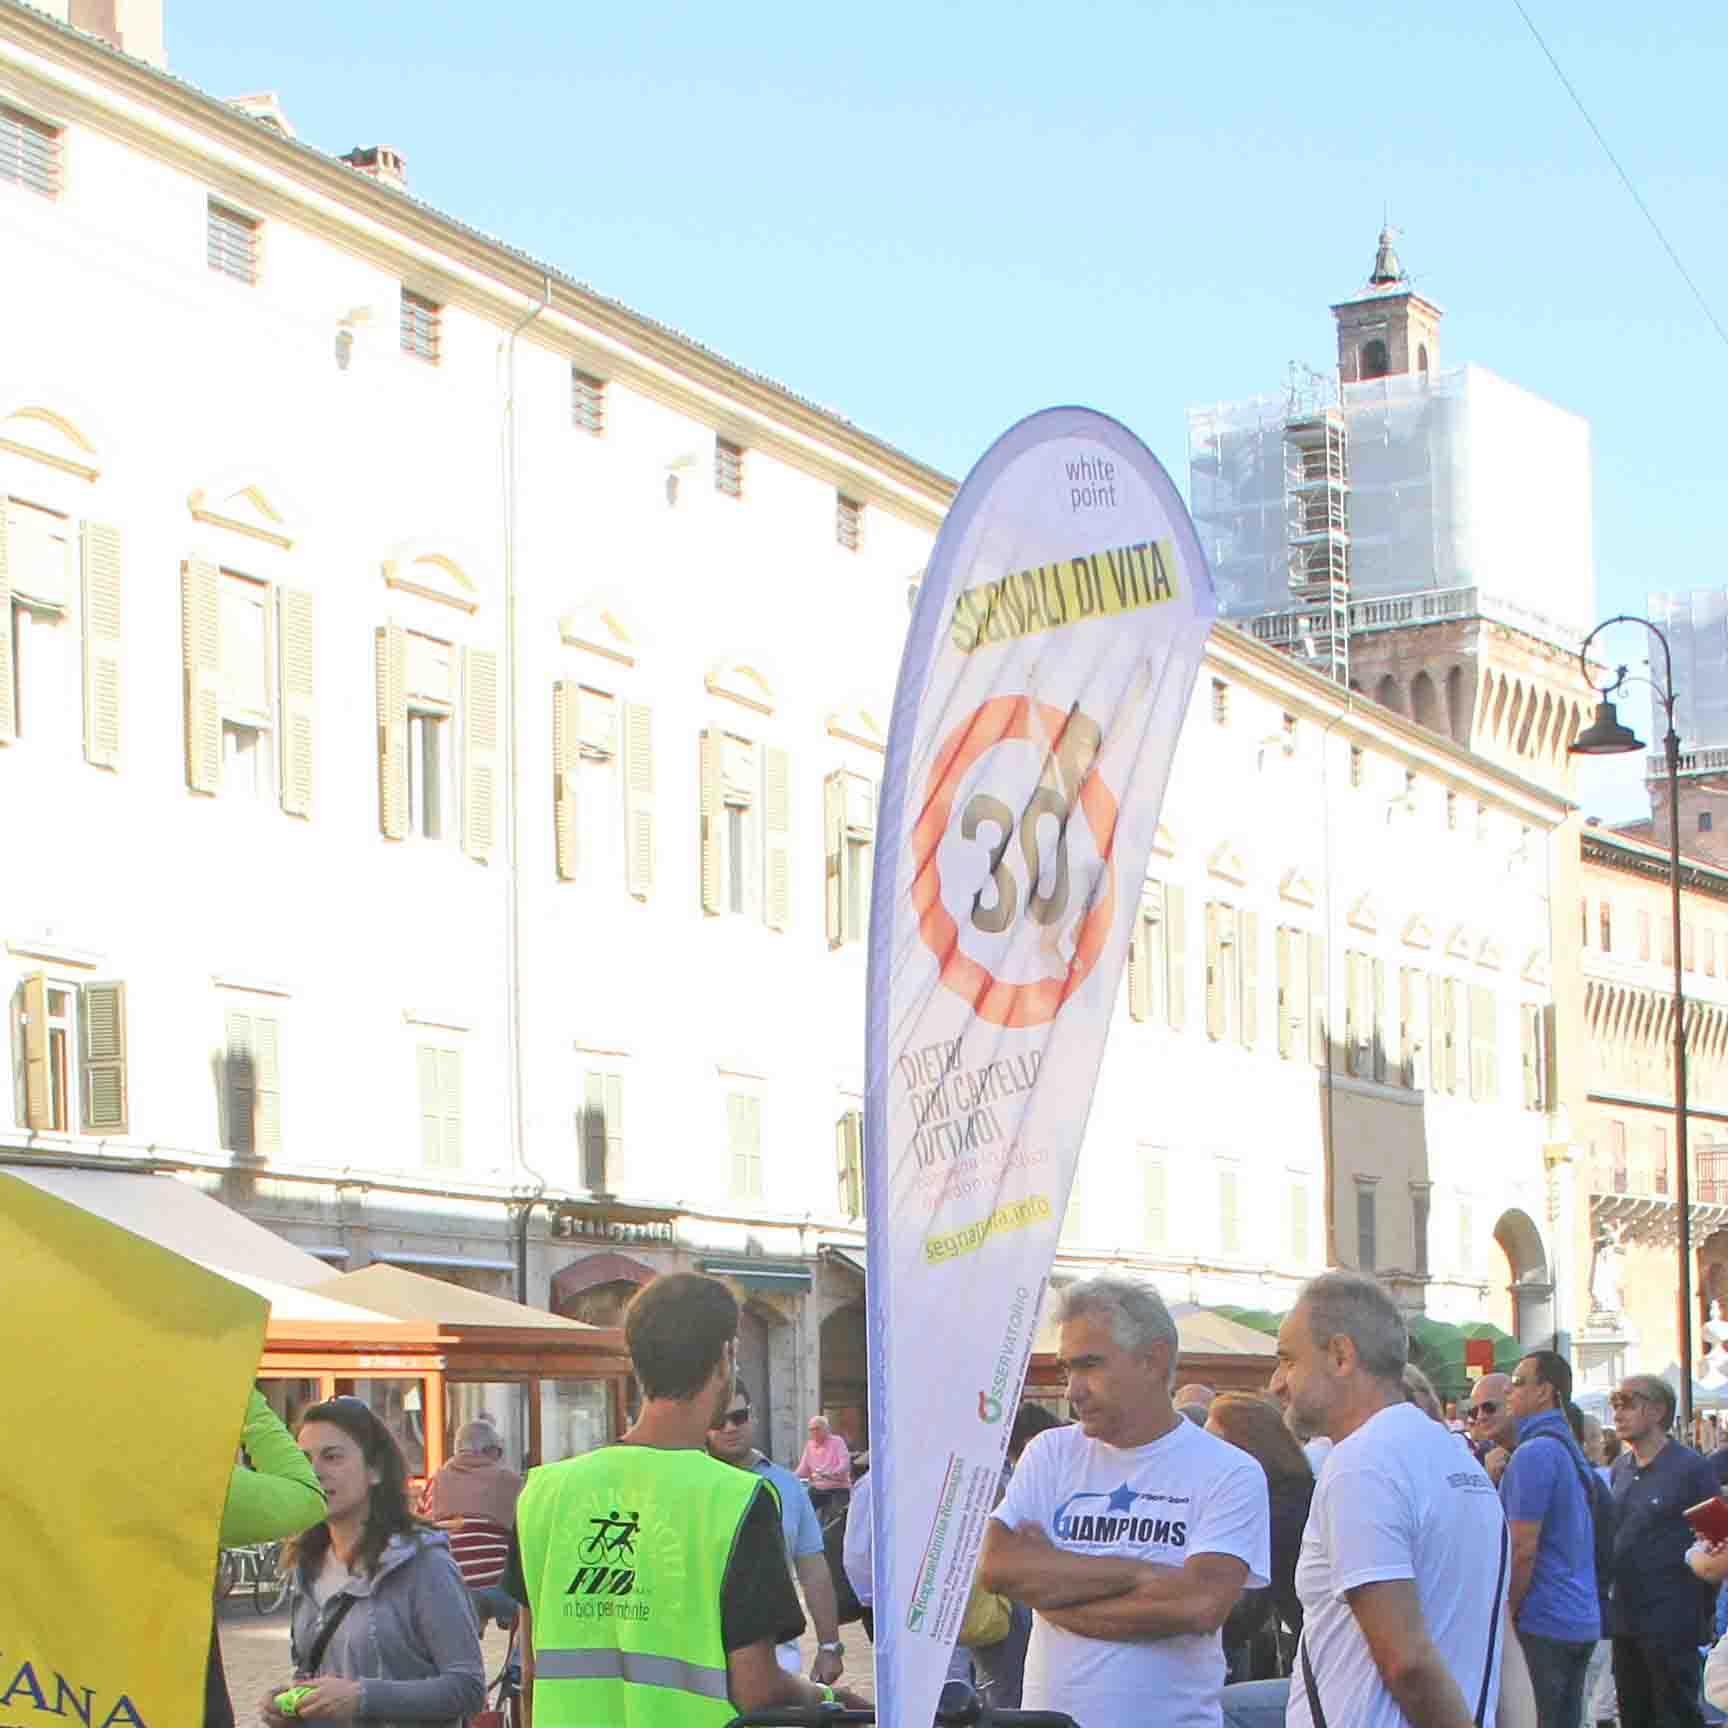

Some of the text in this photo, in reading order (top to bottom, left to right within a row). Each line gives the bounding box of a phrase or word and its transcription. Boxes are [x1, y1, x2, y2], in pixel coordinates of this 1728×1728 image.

[1065, 453, 1115, 481] white
[1071, 482, 1117, 512] point
[952, 540, 1172, 654] SEGNALI DI VITA
[961, 786, 1070, 935] 30
